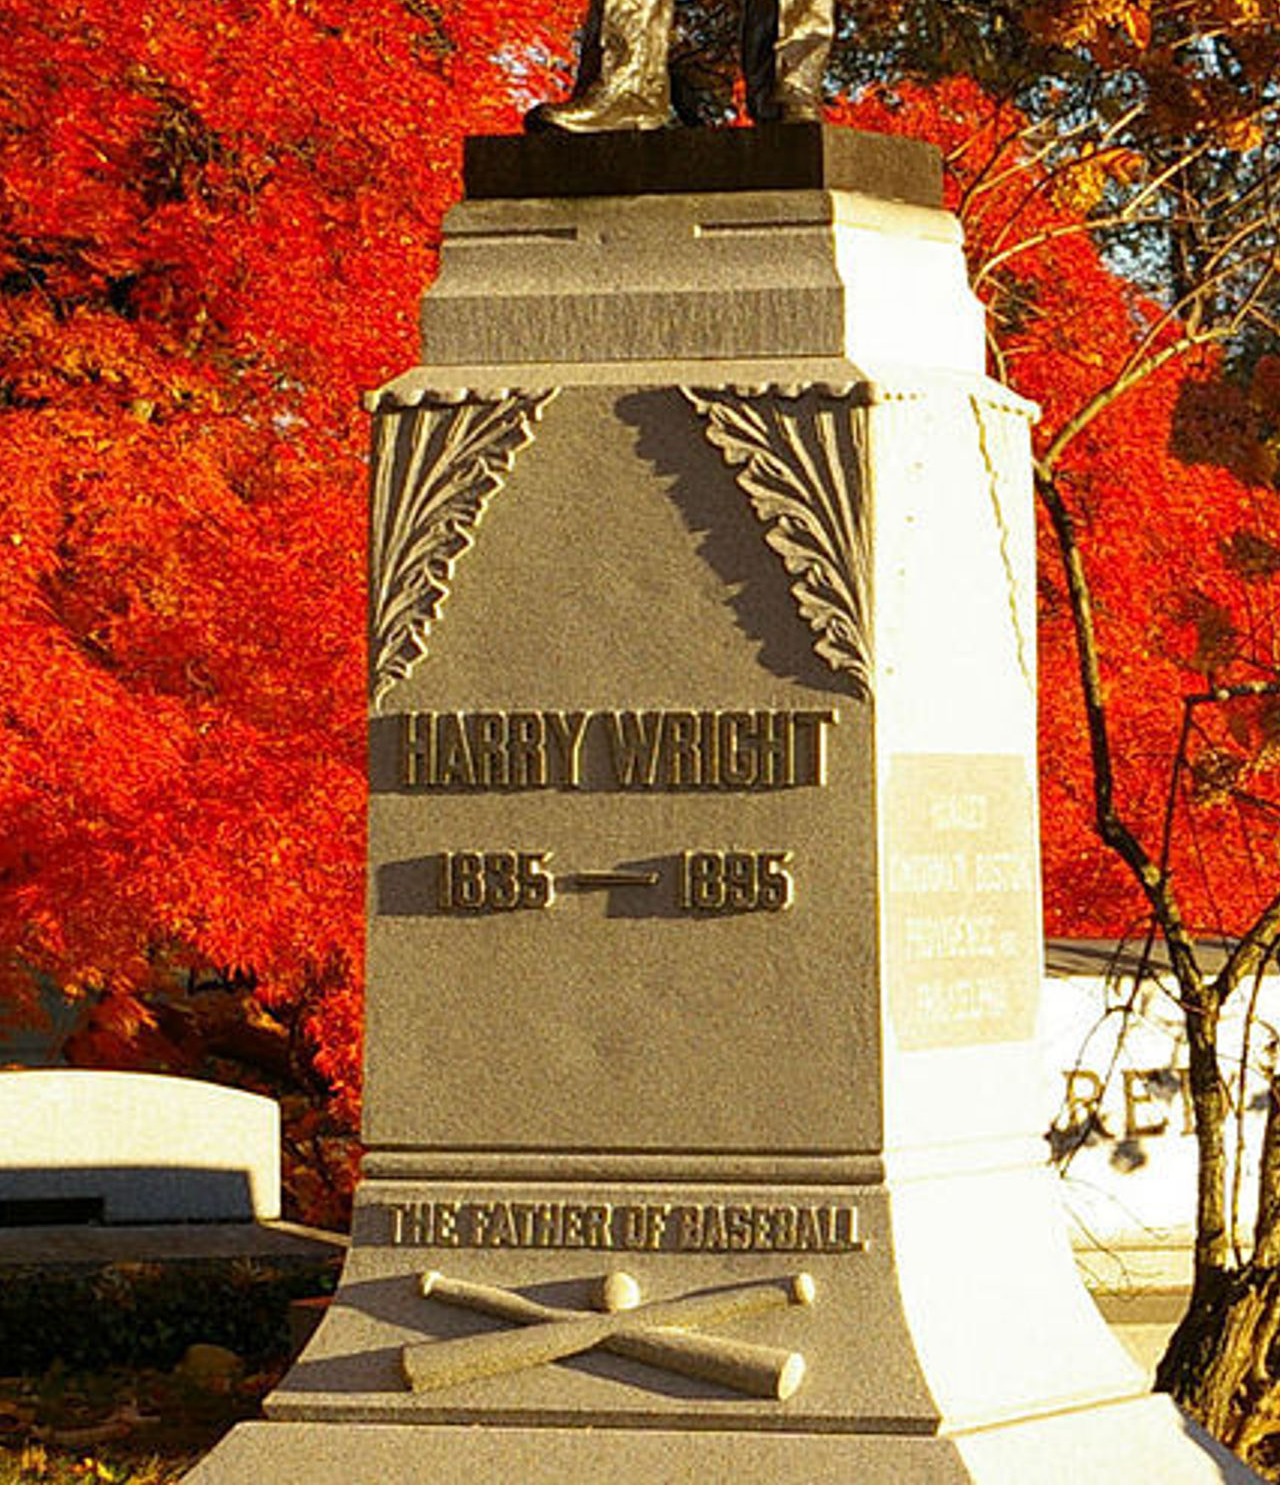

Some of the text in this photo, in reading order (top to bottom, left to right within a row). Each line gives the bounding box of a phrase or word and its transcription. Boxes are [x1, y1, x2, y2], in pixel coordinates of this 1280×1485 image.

[404, 710, 838, 786] HARRY WRIGHT
[438, 850, 555, 909] 1835
[679, 850, 795, 909] 1895
[389, 1201, 869, 1253] THE FATHER OF BASEBALL
